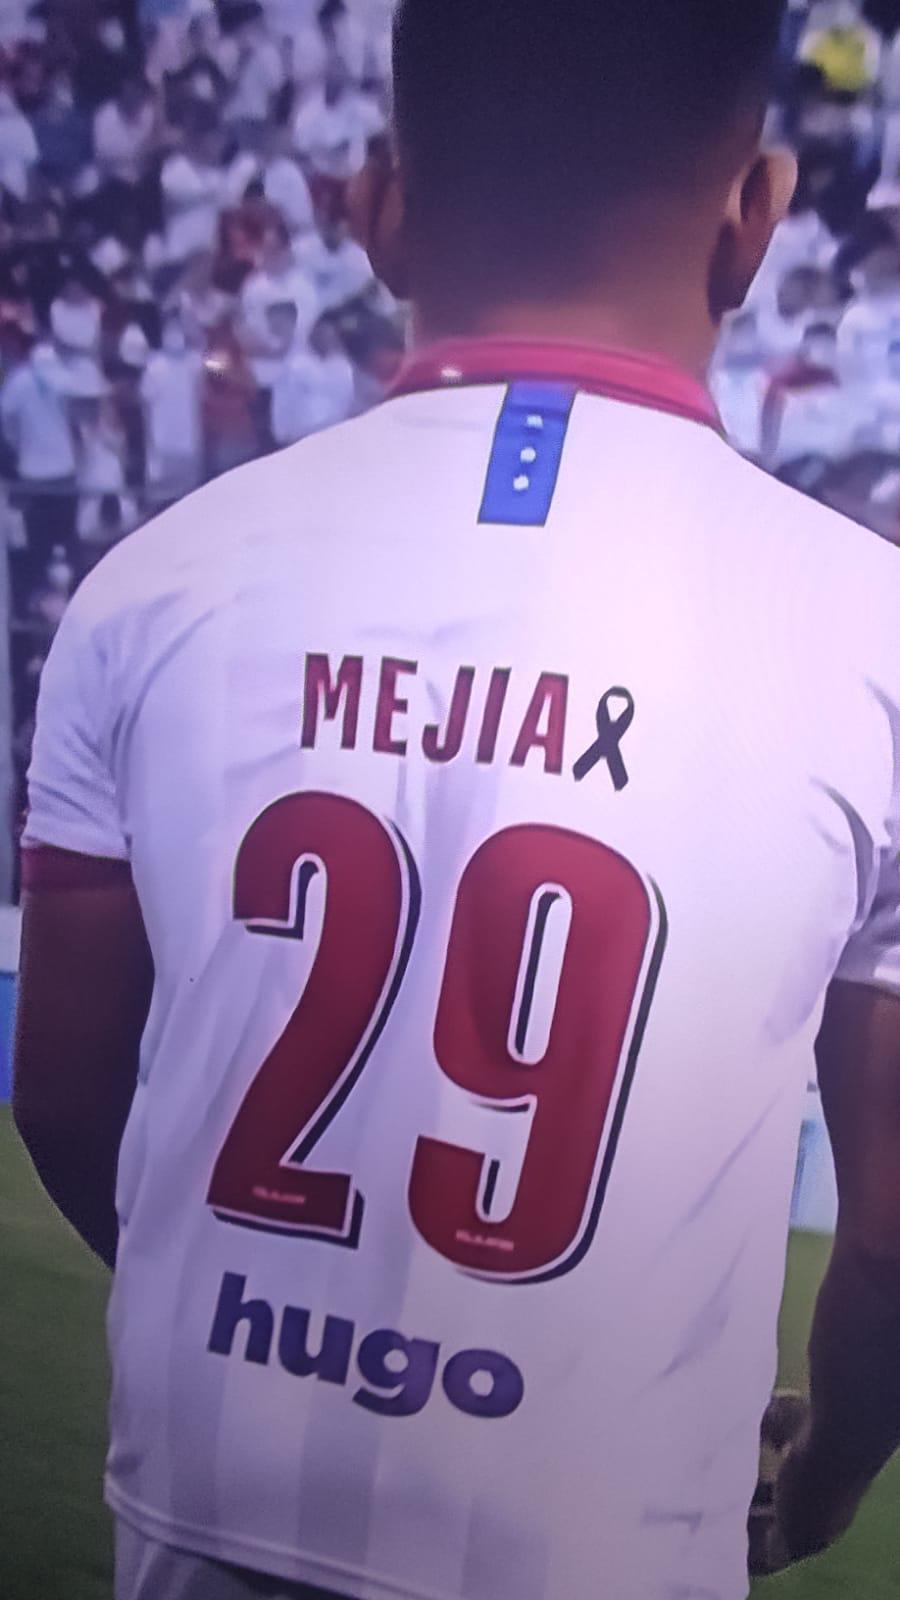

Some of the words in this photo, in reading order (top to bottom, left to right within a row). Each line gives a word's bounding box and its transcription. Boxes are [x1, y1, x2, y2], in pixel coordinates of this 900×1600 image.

[300, 652, 569, 775] MEJIA
[206, 790, 668, 1285] 29
[208, 1271, 525, 1419] hugo
